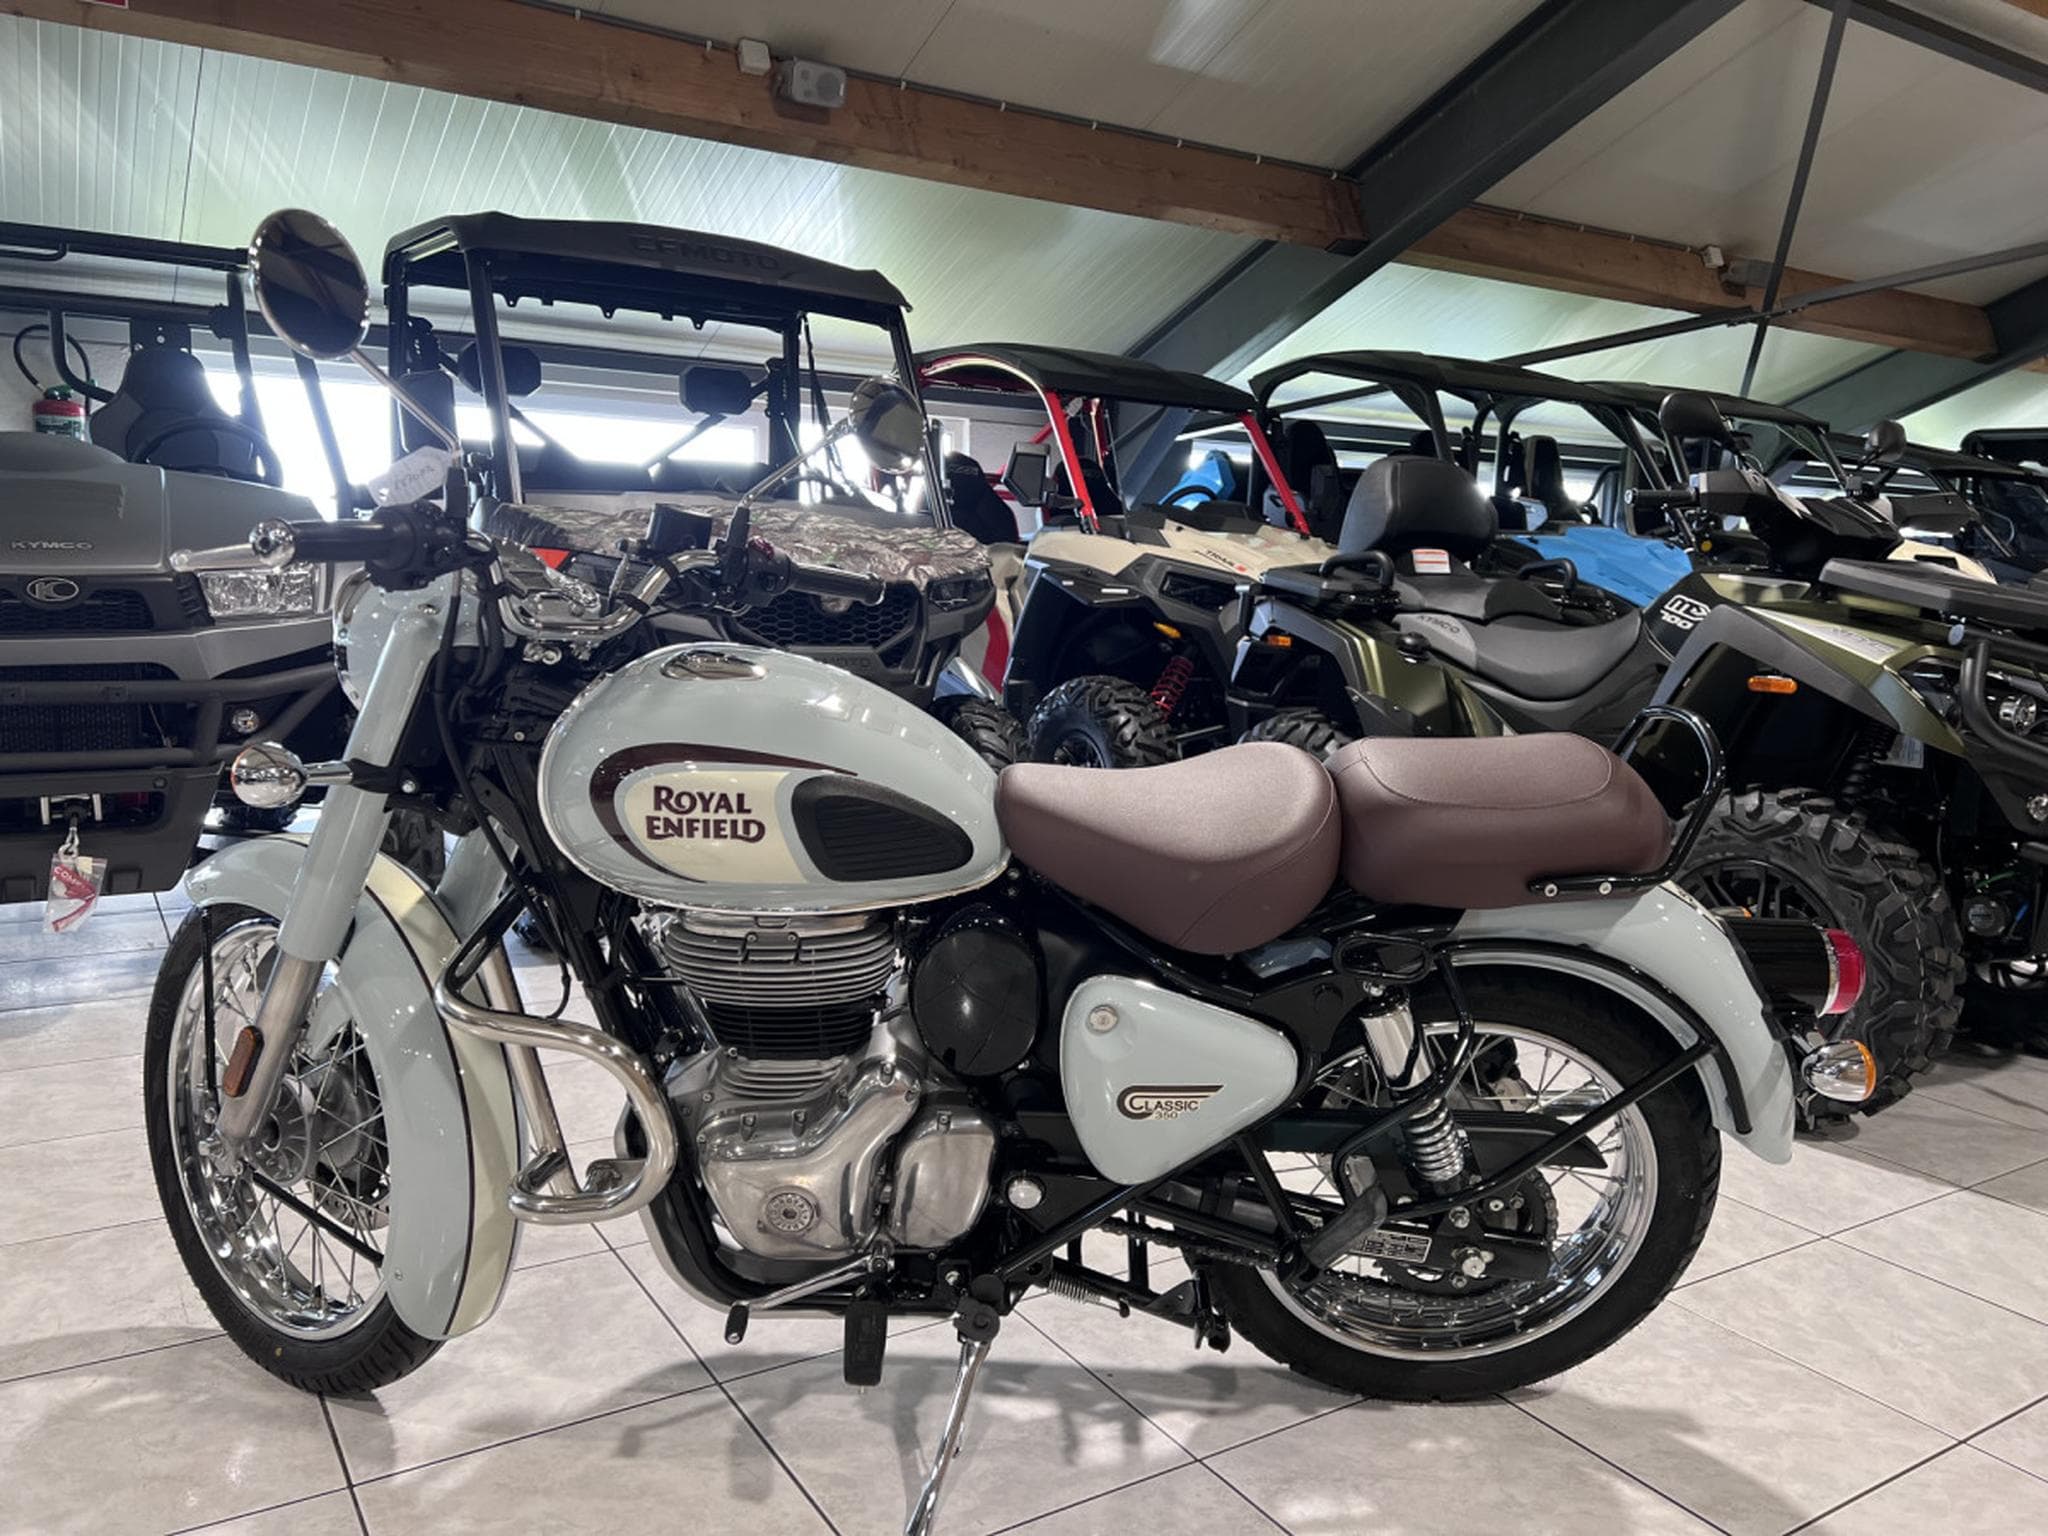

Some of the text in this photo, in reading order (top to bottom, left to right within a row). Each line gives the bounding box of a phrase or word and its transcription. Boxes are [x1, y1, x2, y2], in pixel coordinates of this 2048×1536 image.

[10, 541, 93, 550] KYMCO
[1659, 608, 1696, 631] 700
[653, 785, 752, 815] ROYAL
[645, 815, 766, 844] ENFIELD
[1154, 1111, 1178, 1120] 350
